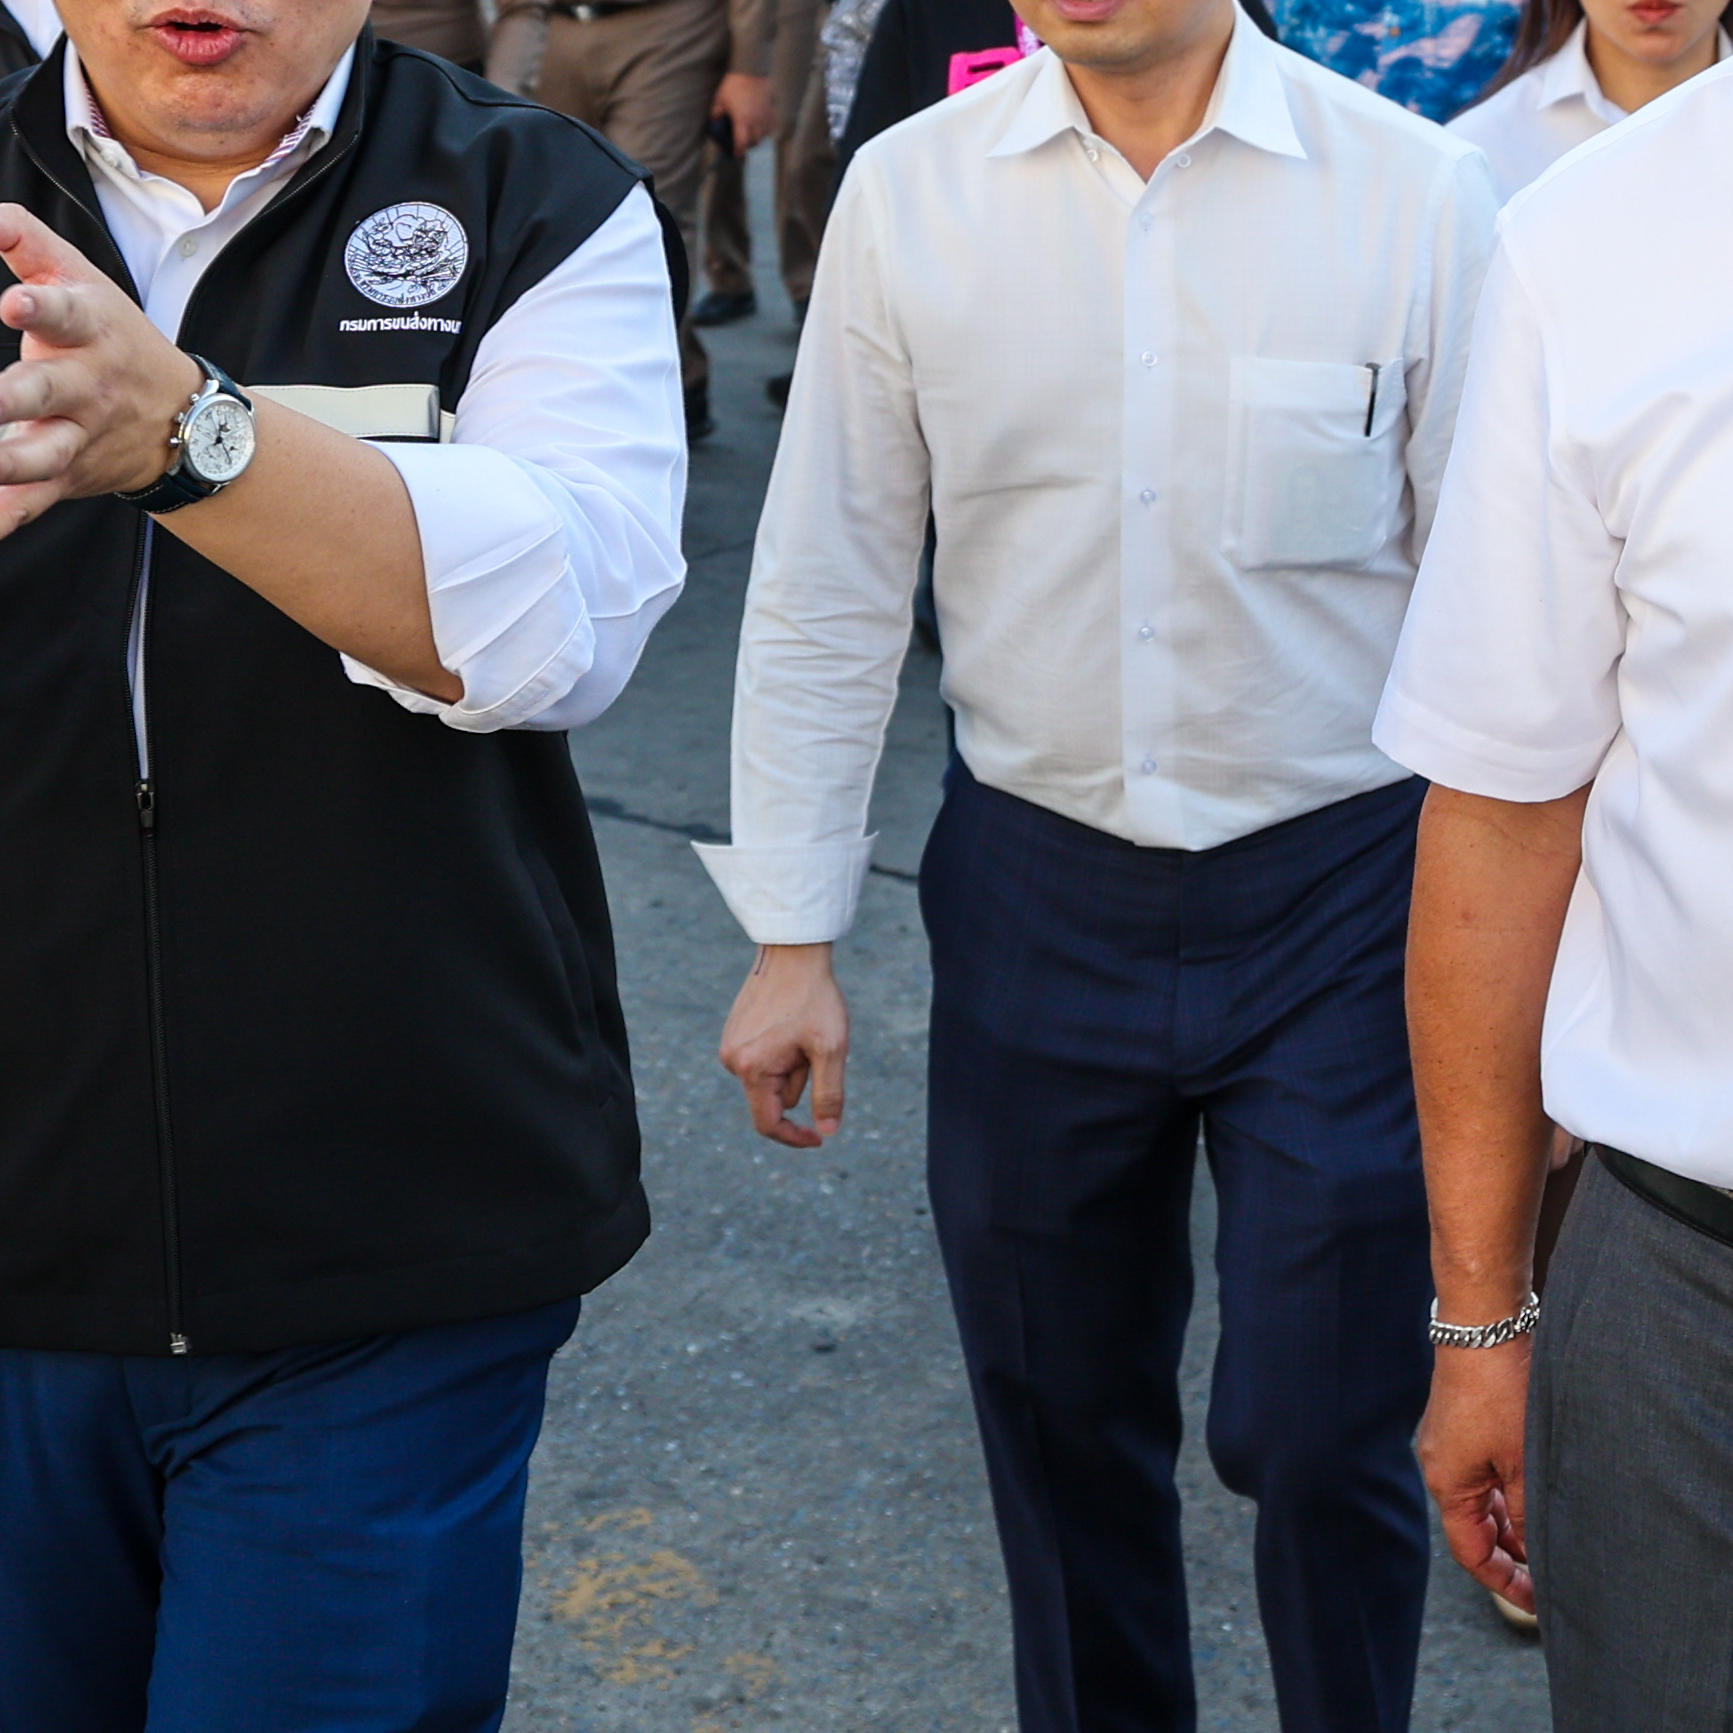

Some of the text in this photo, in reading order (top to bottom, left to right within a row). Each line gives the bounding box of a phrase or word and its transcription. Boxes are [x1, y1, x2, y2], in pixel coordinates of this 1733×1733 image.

[339, 310, 462, 334] กรมการขนส่งทางบ
